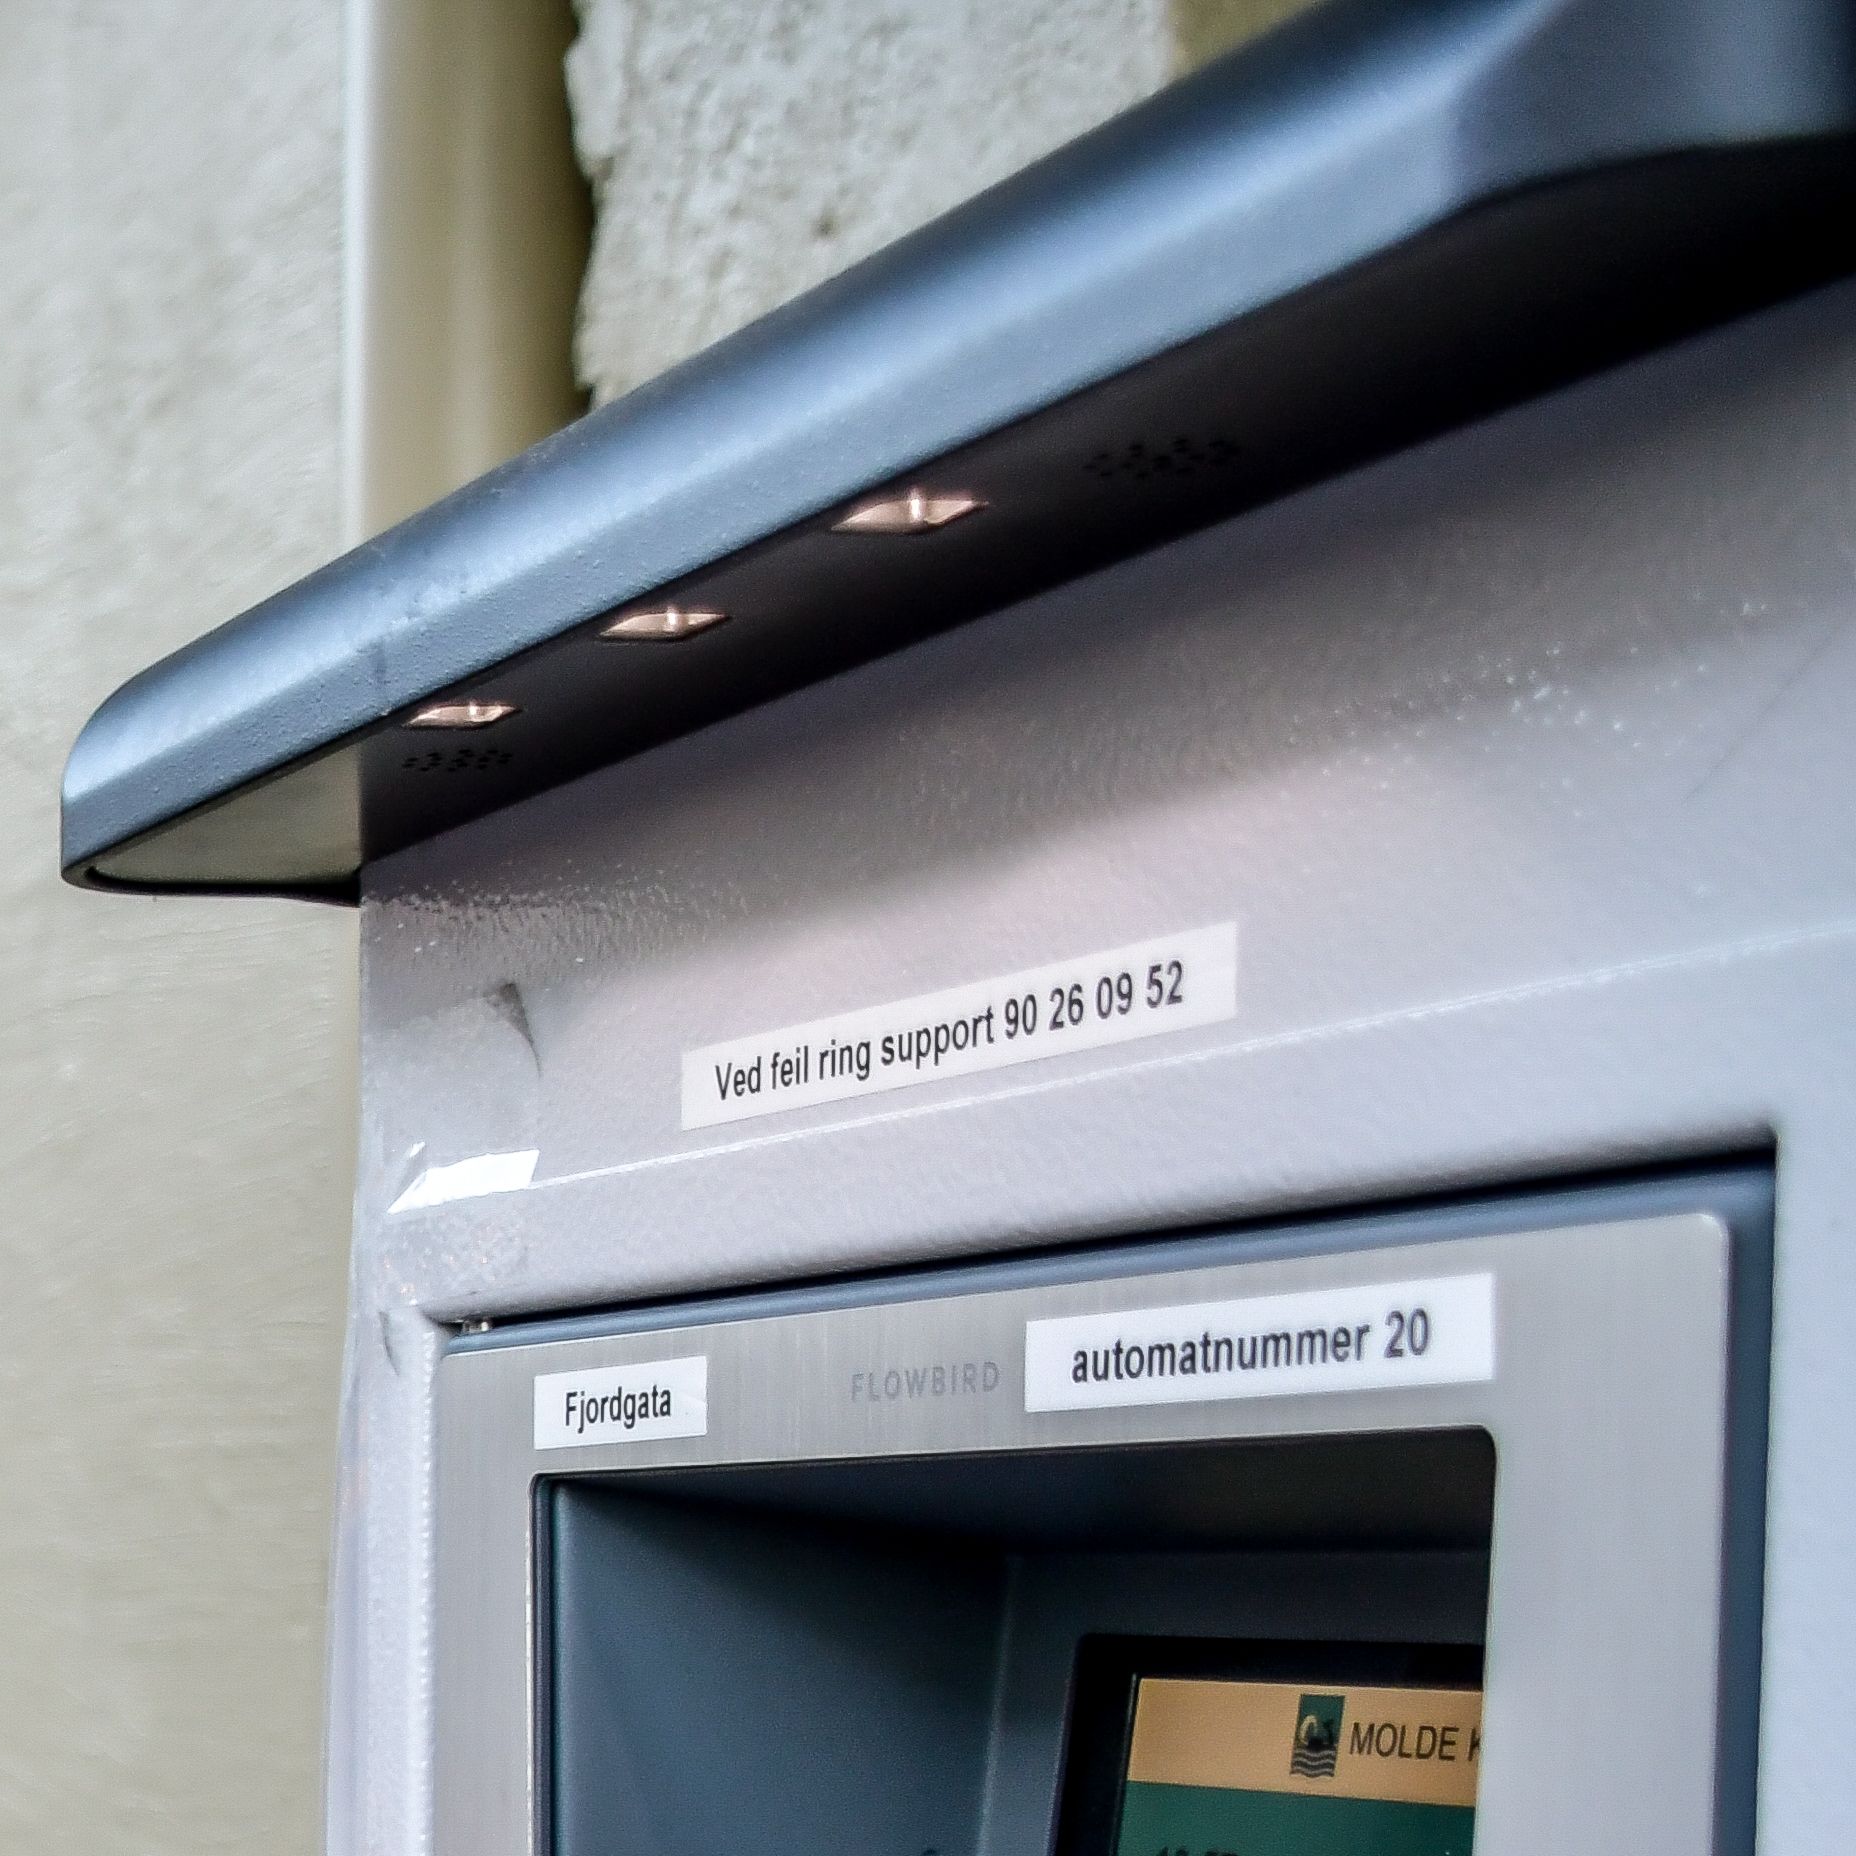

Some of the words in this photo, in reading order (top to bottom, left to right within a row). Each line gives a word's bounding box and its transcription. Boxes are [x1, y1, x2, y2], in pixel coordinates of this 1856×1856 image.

[715, 1055, 761, 1100] Ved
[771, 1045, 809, 1089] feil
[819, 1039, 871, 1081] ring
[880, 1005, 994, 1069] support
[1005, 994, 1037, 1039] 90
[1049, 983, 1084, 1031] 26
[1096, 971, 1133, 1019] 09
[1147, 959, 1183, 1008] 52
[1071, 1323, 1370, 1383] automatnummer
[1384, 1308, 1429, 1358] 20
[851, 1361, 1001, 1402] FLOWBIRD
[565, 1384, 672, 1433] Fjordgata
[1349, 1722, 1460, 1761] MOLDE
